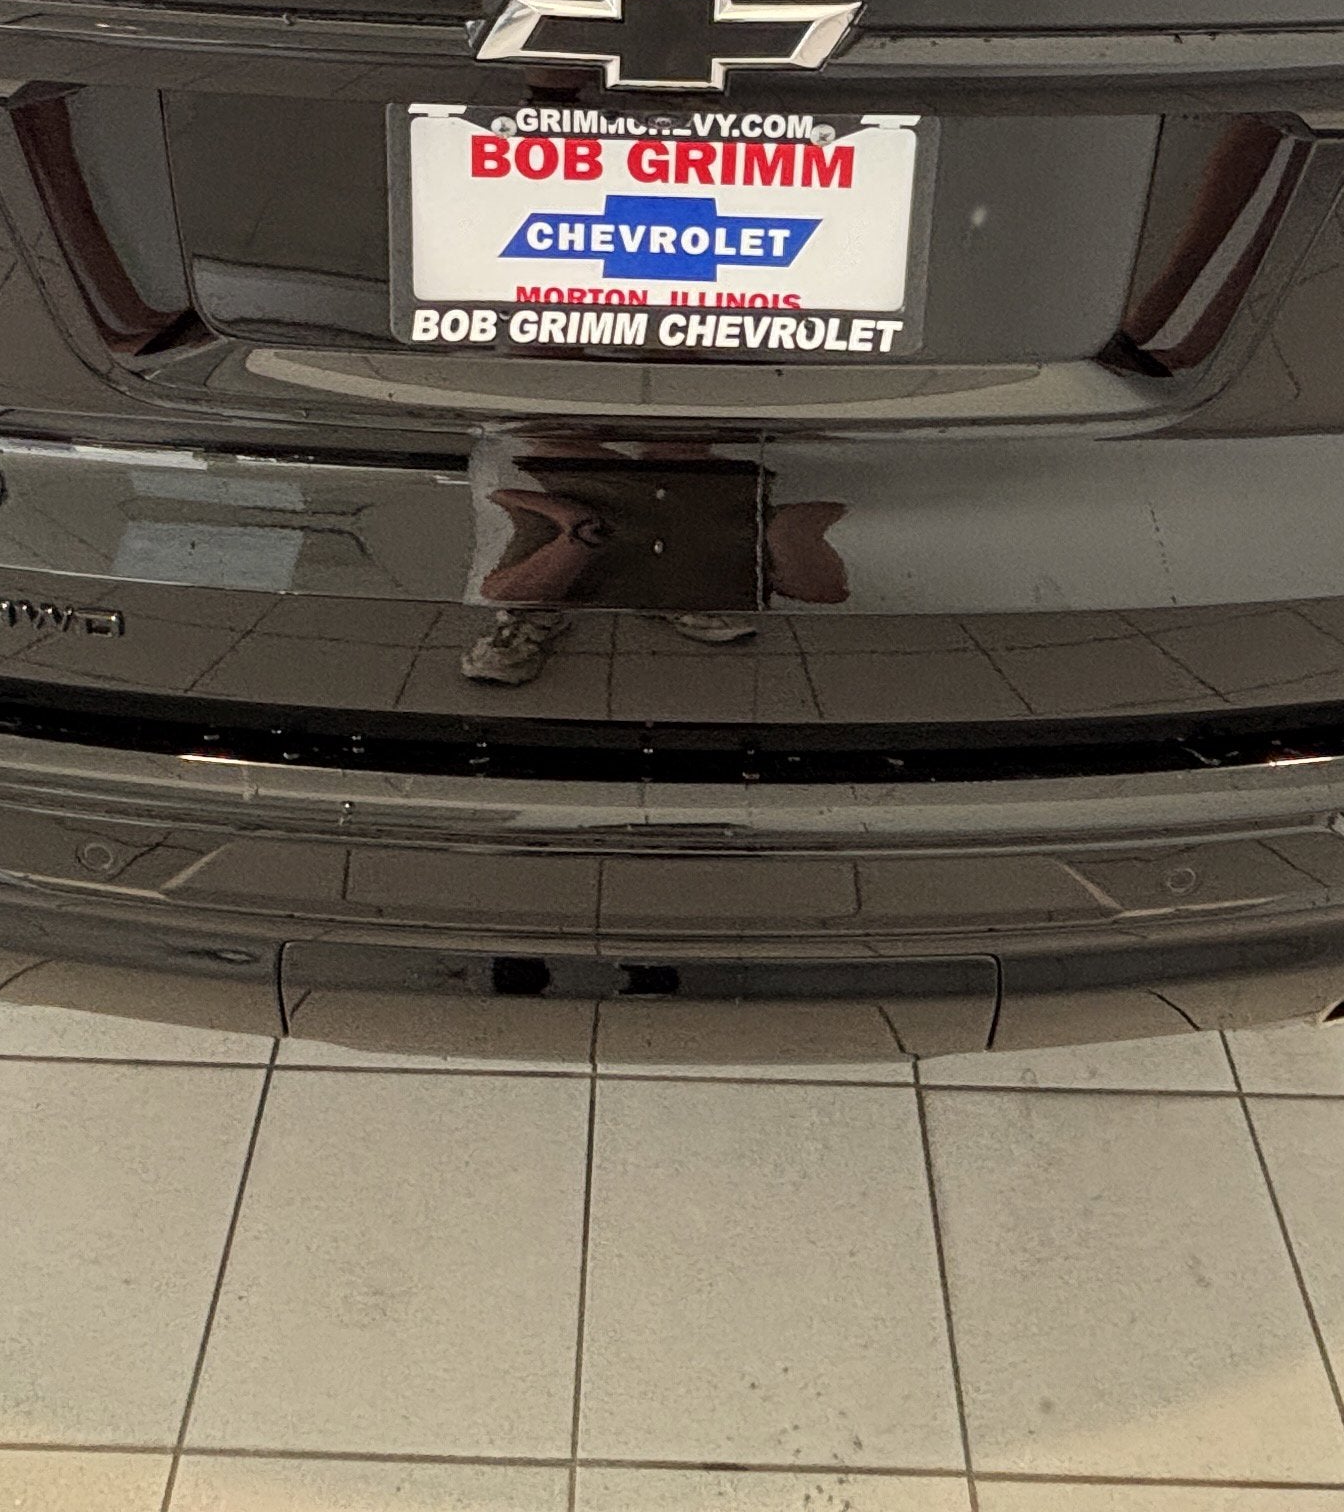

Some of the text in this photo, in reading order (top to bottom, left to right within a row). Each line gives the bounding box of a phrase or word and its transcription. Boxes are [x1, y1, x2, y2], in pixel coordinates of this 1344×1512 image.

[471, 134, 856, 189] BOB GRIMM
[525, 220, 792, 259] CHEVROLET
[411, 308, 904, 354] BOB GRIMM CHEVROLET
